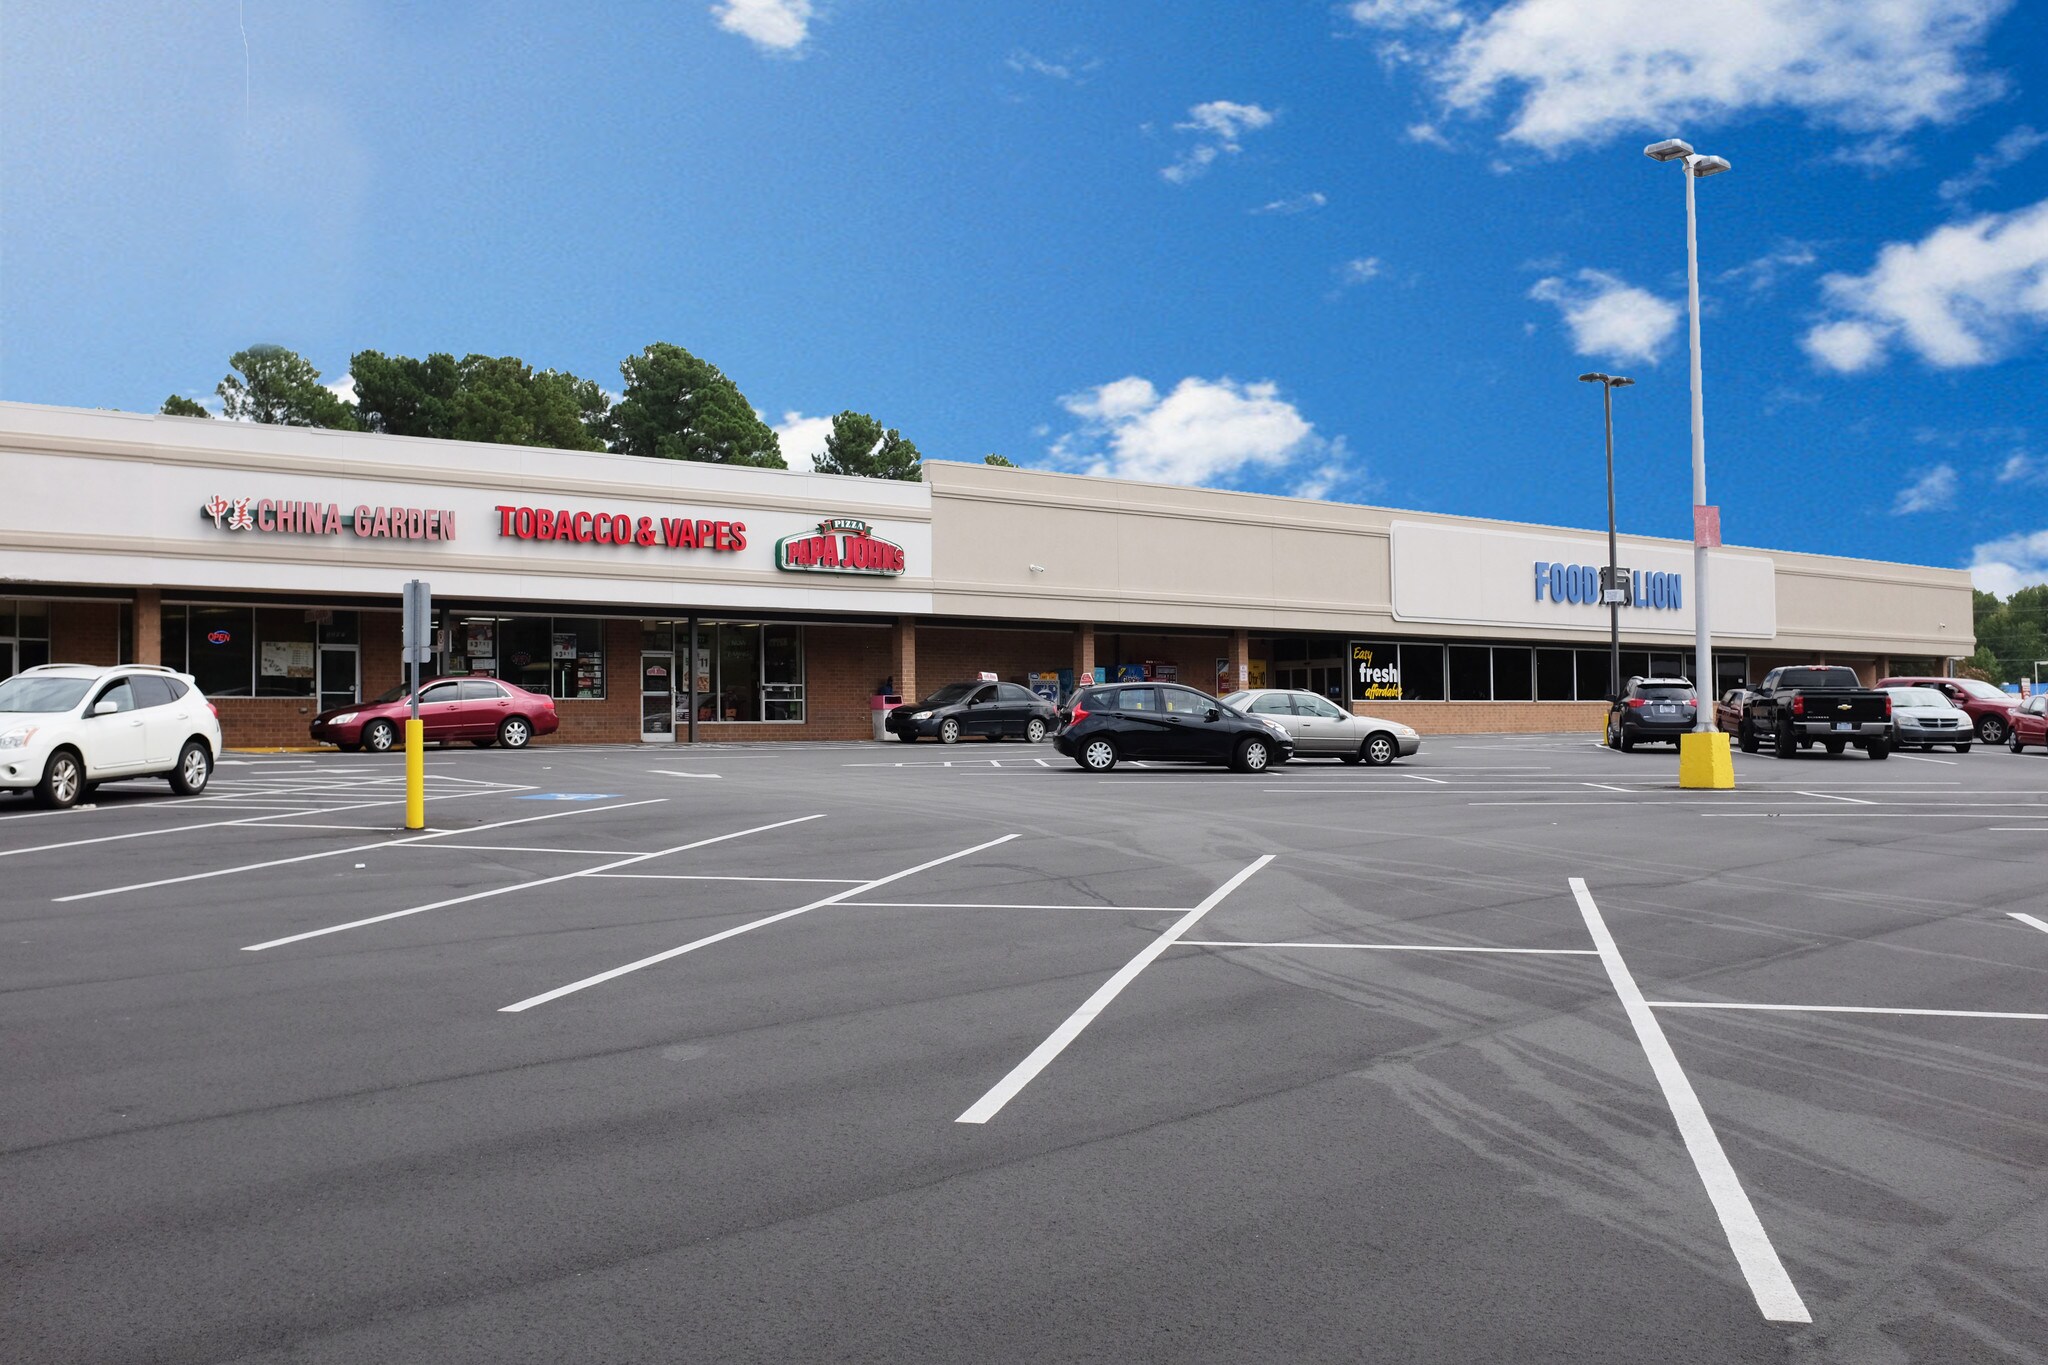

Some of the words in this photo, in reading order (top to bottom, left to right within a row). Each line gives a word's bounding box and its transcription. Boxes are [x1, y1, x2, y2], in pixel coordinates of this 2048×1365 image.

[205, 494, 253, 531] 中美
[258, 498, 343, 535] CHINA
[354, 504, 456, 541] GARDEN
[495, 505, 632, 545] TOBACCO
[635, 516, 657, 546] &
[661, 517, 747, 551] VAPES
[834, 519, 864, 530] PIZZA
[786, 534, 840, 567] PAPA
[1535, 561, 1598, 604] FOOD
[1633, 570, 1682, 610] LION
[207, 632, 231, 642] OPEN
[1359, 662, 1398, 683] fresh
